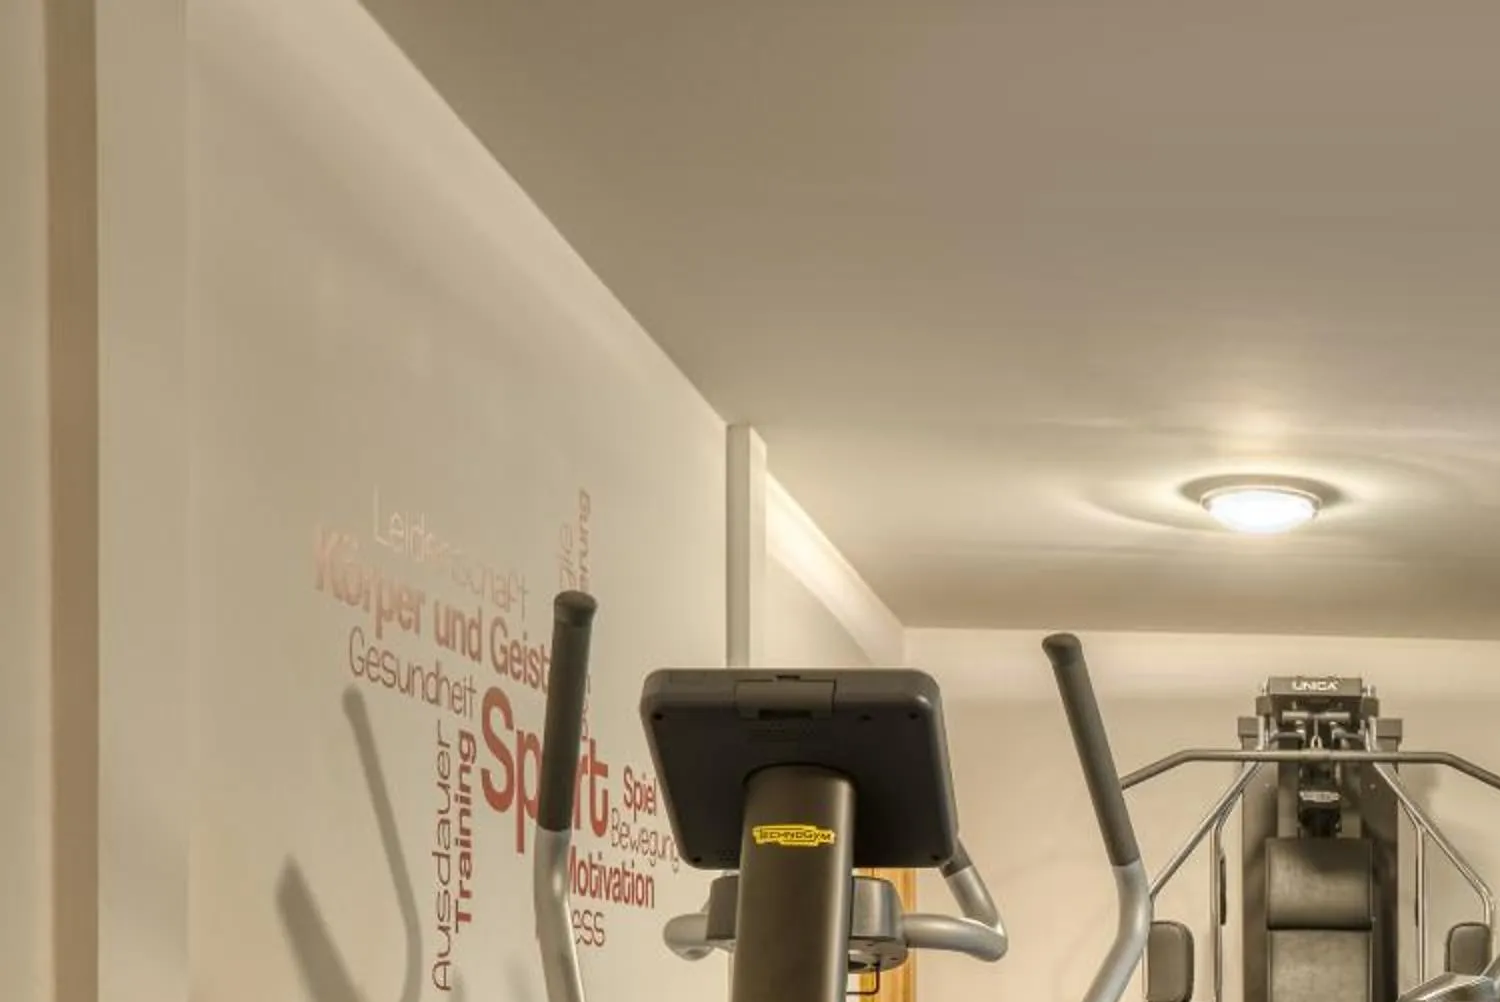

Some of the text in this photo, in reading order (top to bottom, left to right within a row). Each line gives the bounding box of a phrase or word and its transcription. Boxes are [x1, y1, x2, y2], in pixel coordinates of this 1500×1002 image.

[349, 625, 477, 718] Gesundheit
[434, 600, 482, 662] und
[490, 616, 551, 694] Geist
[454, 730, 477, 934] Training
[480, 686, 609, 854] Sprt
[431, 720, 452, 991] Ausdauer
[611, 807, 680, 874] Bewegung
